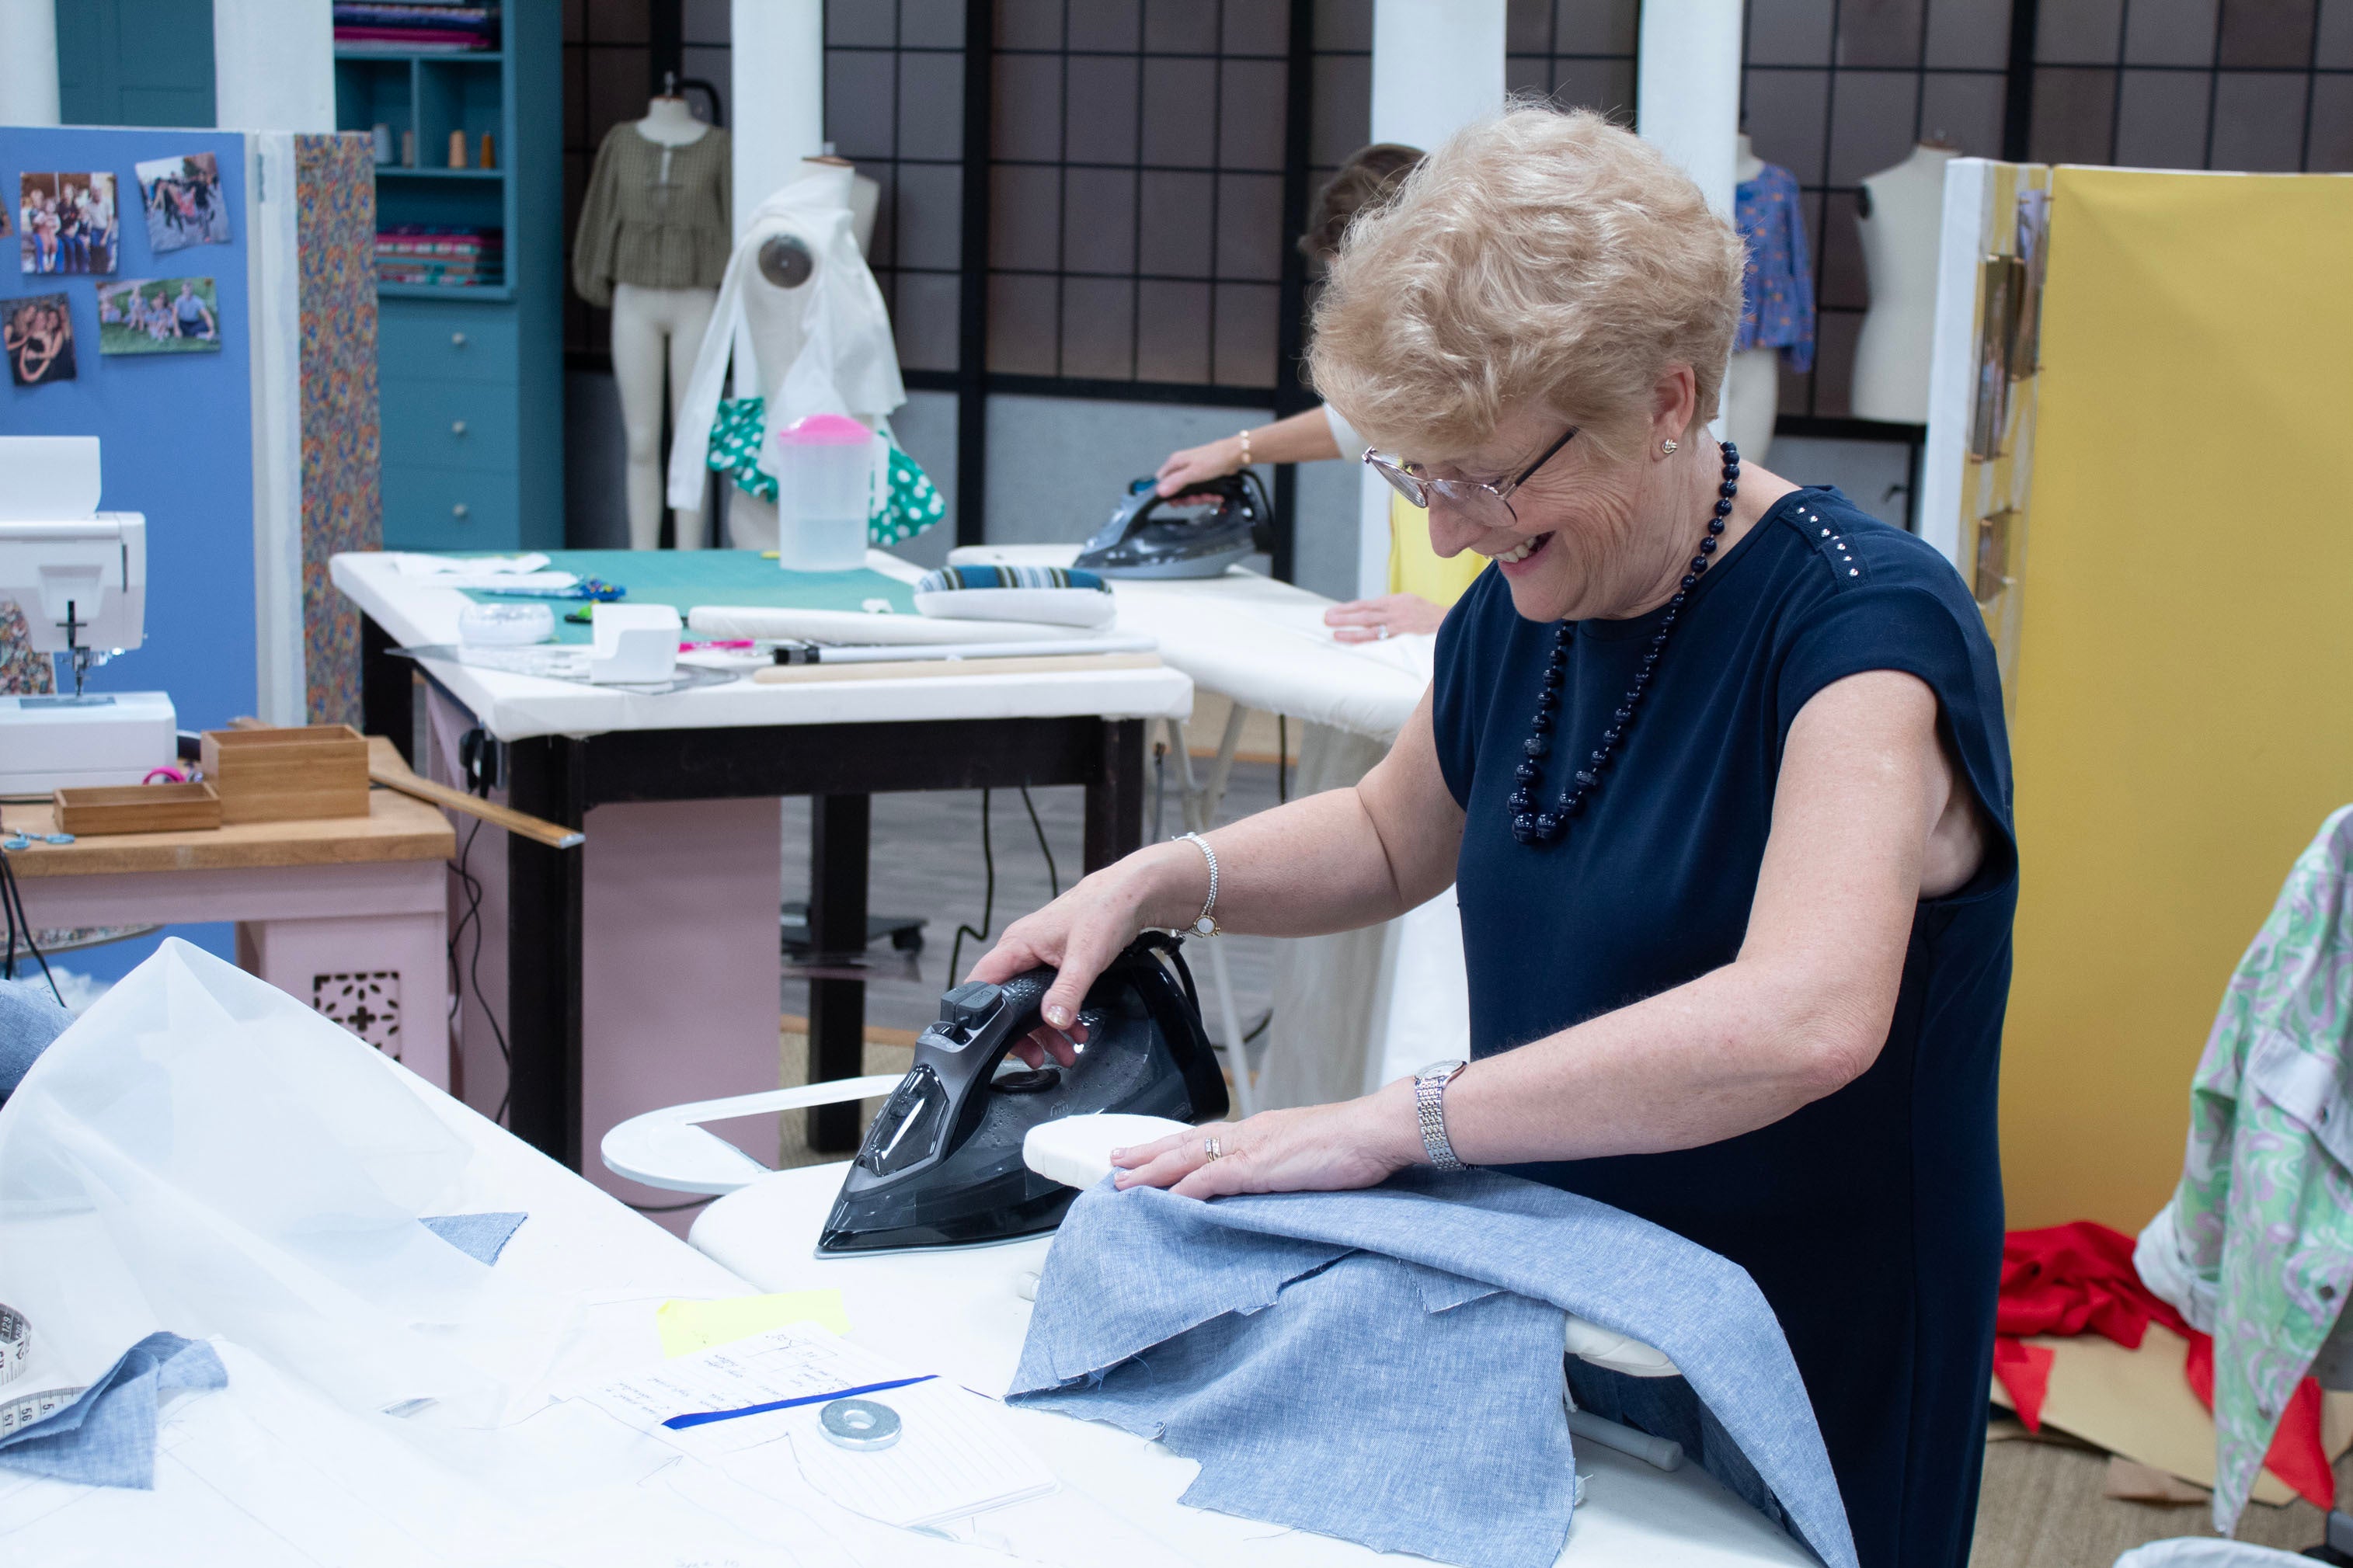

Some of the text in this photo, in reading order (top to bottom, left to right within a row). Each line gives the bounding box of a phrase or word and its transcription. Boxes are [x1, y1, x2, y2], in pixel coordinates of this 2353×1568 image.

[2, 1316, 11, 1333] 129
[4, 1413, 13, 1427] 57
[21, 1407, 33, 1421] 56
